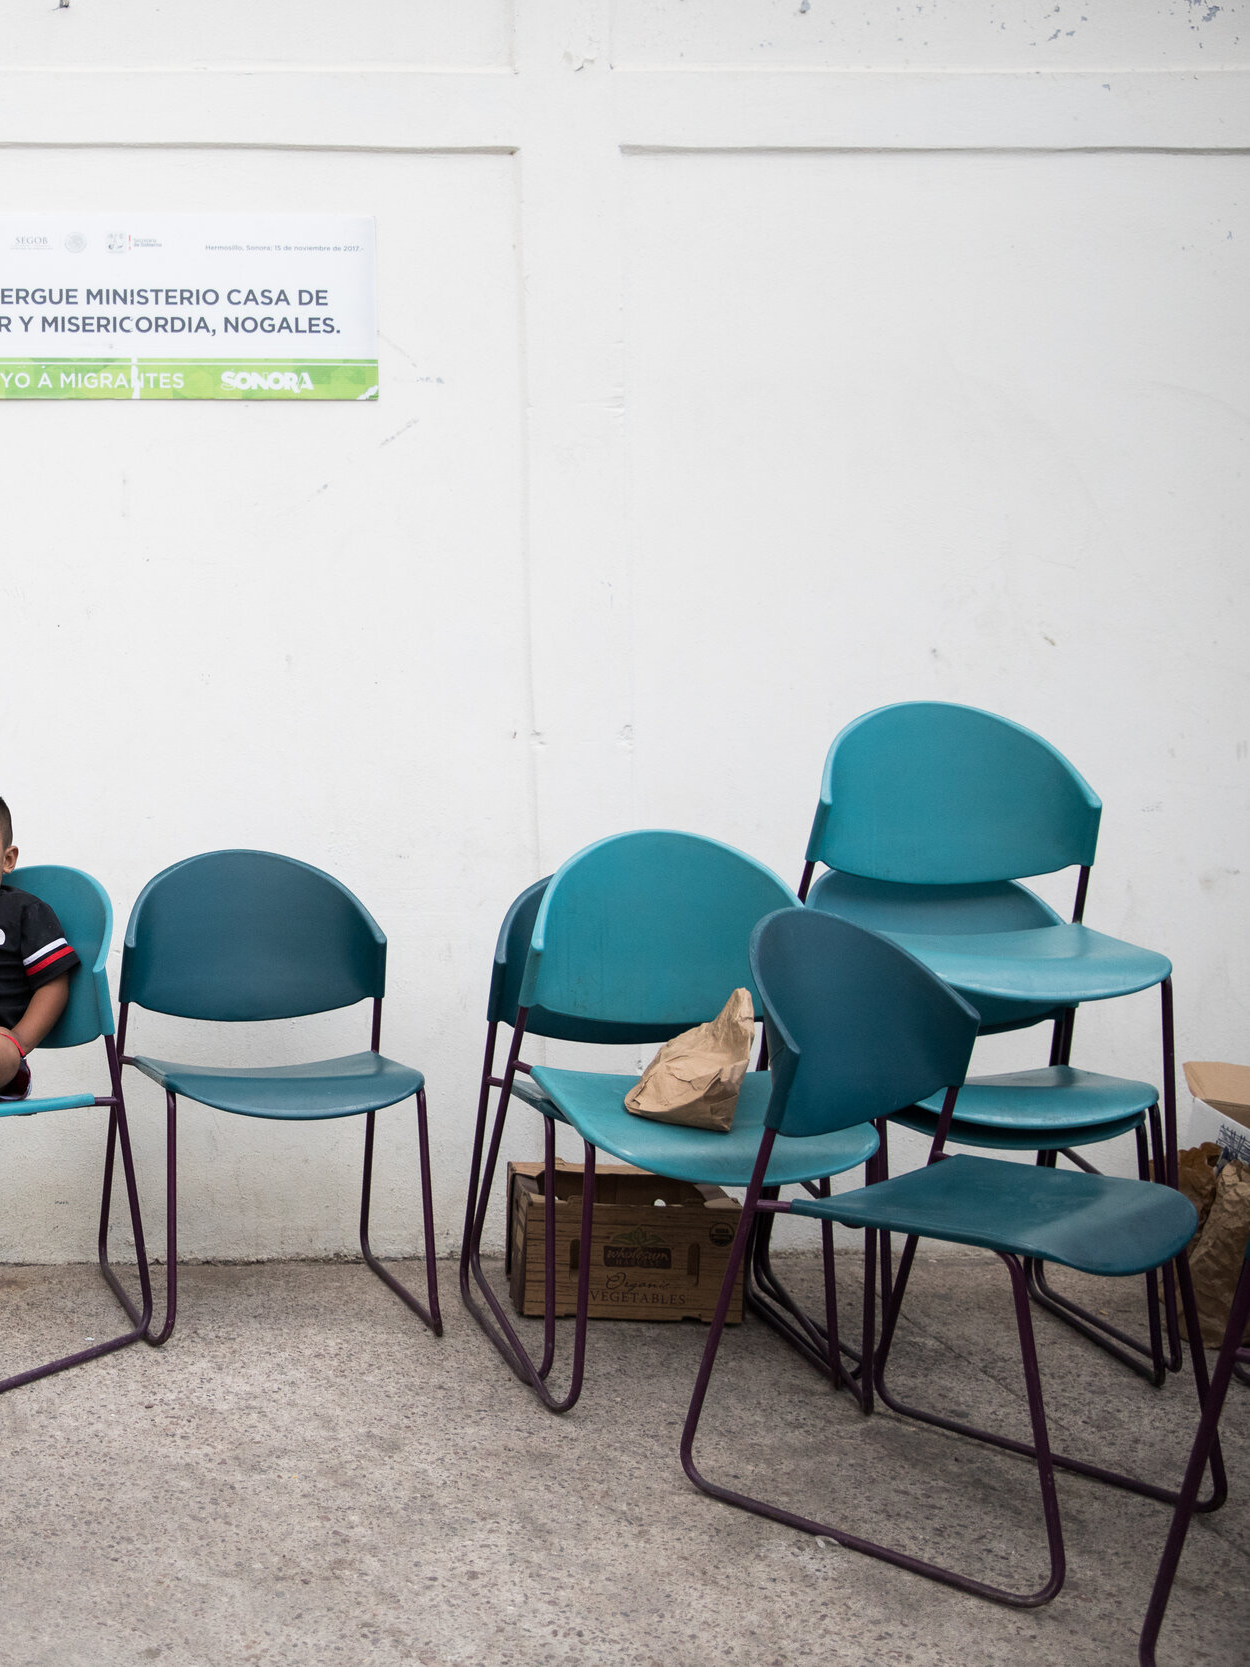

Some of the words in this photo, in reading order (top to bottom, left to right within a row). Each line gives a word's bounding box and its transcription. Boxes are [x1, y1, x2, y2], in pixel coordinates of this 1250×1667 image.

[15, 236, 49, 245] SEGOB
[86, 288, 220, 306] MINISTERIO
[226, 288, 291, 306] CASA
[298, 289, 329, 305] DE
[18, 316, 34, 333] Y
[41, 315, 217, 337] MISERICORDIA,
[223, 316, 341, 334] NOGALES.
[37, 372, 54, 389] A
[60, 372, 185, 389] MIGRANTES
[220, 369, 315, 393] SONORA
[605, 1271, 670, 1292] Organic
[589, 1290, 686, 1305] VEGETABLES
